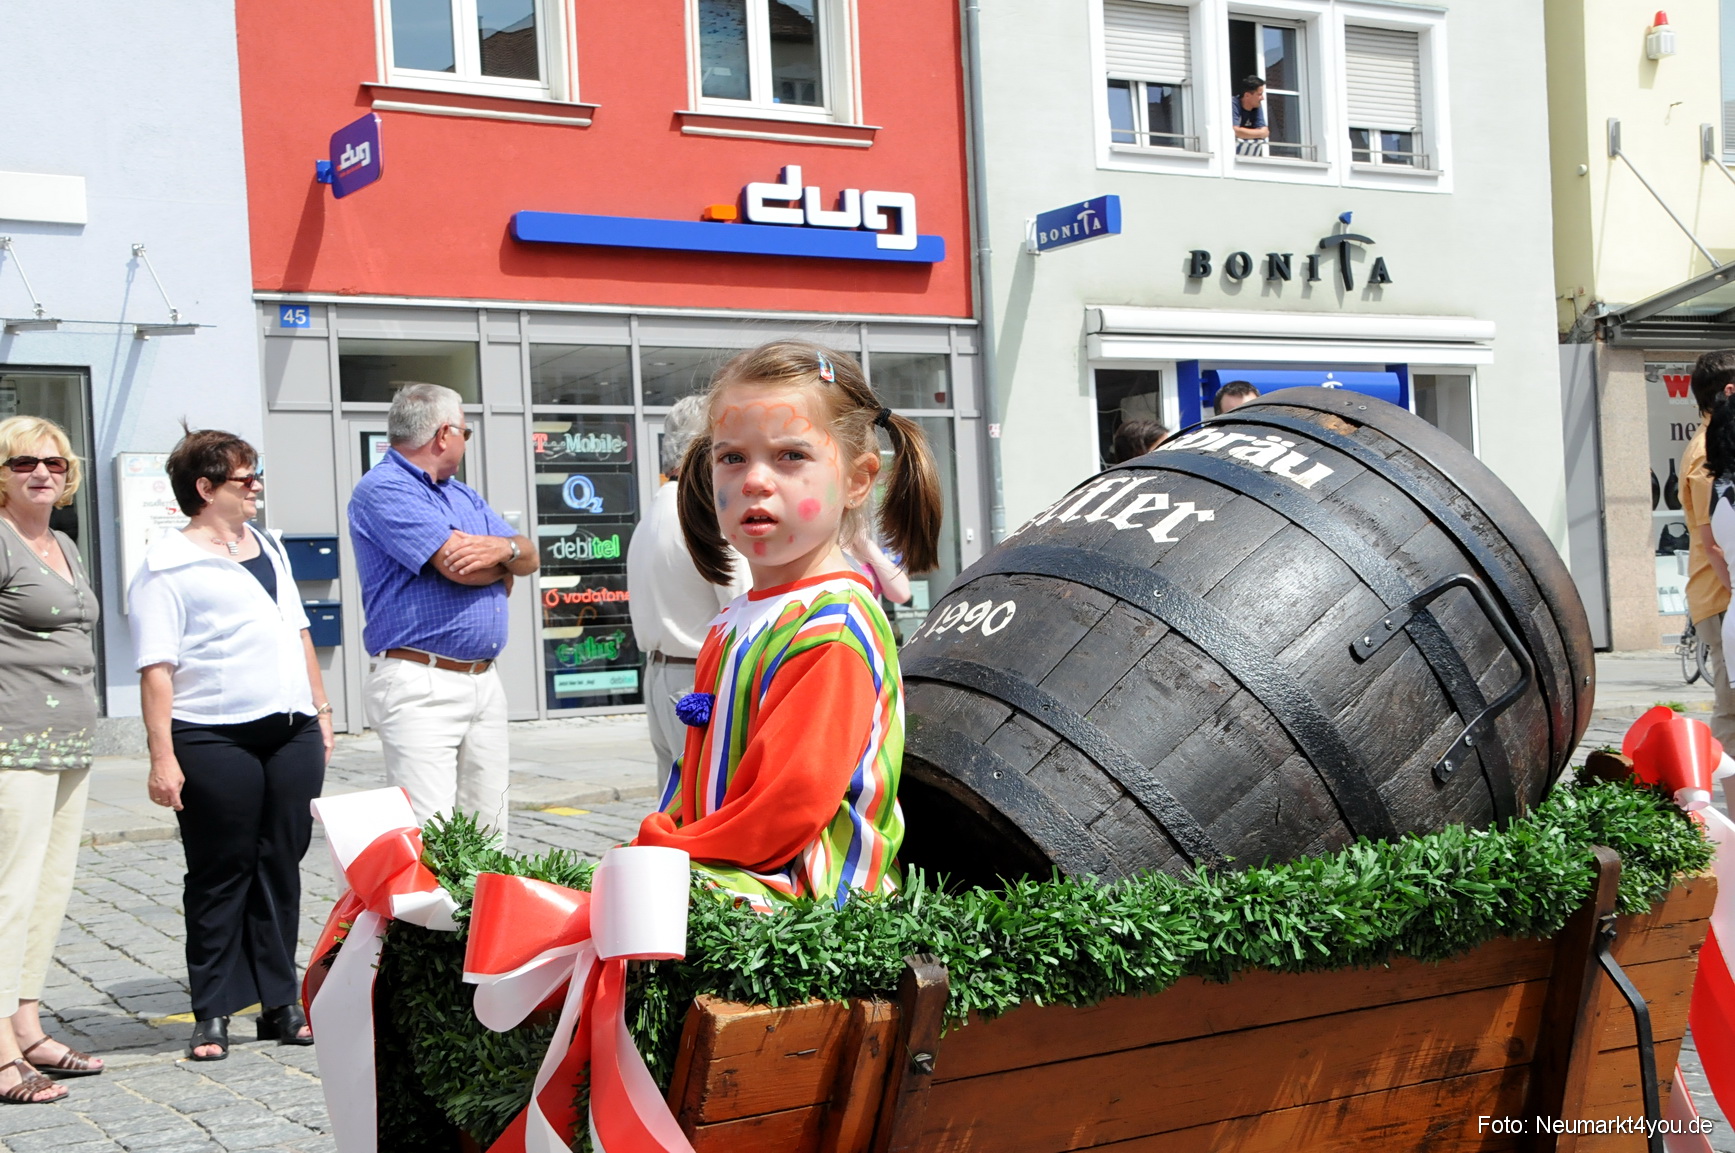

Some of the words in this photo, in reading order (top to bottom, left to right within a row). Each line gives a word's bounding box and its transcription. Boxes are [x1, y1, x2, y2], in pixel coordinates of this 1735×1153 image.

[1039, 202, 1102, 244] BONITA
[1188, 211, 1393, 292] BONITA
[283, 309, 307, 324] 45
[1670, 422, 1701, 442] ne
[553, 534, 620, 559] debitel
[924, 599, 1017, 638] 1990
